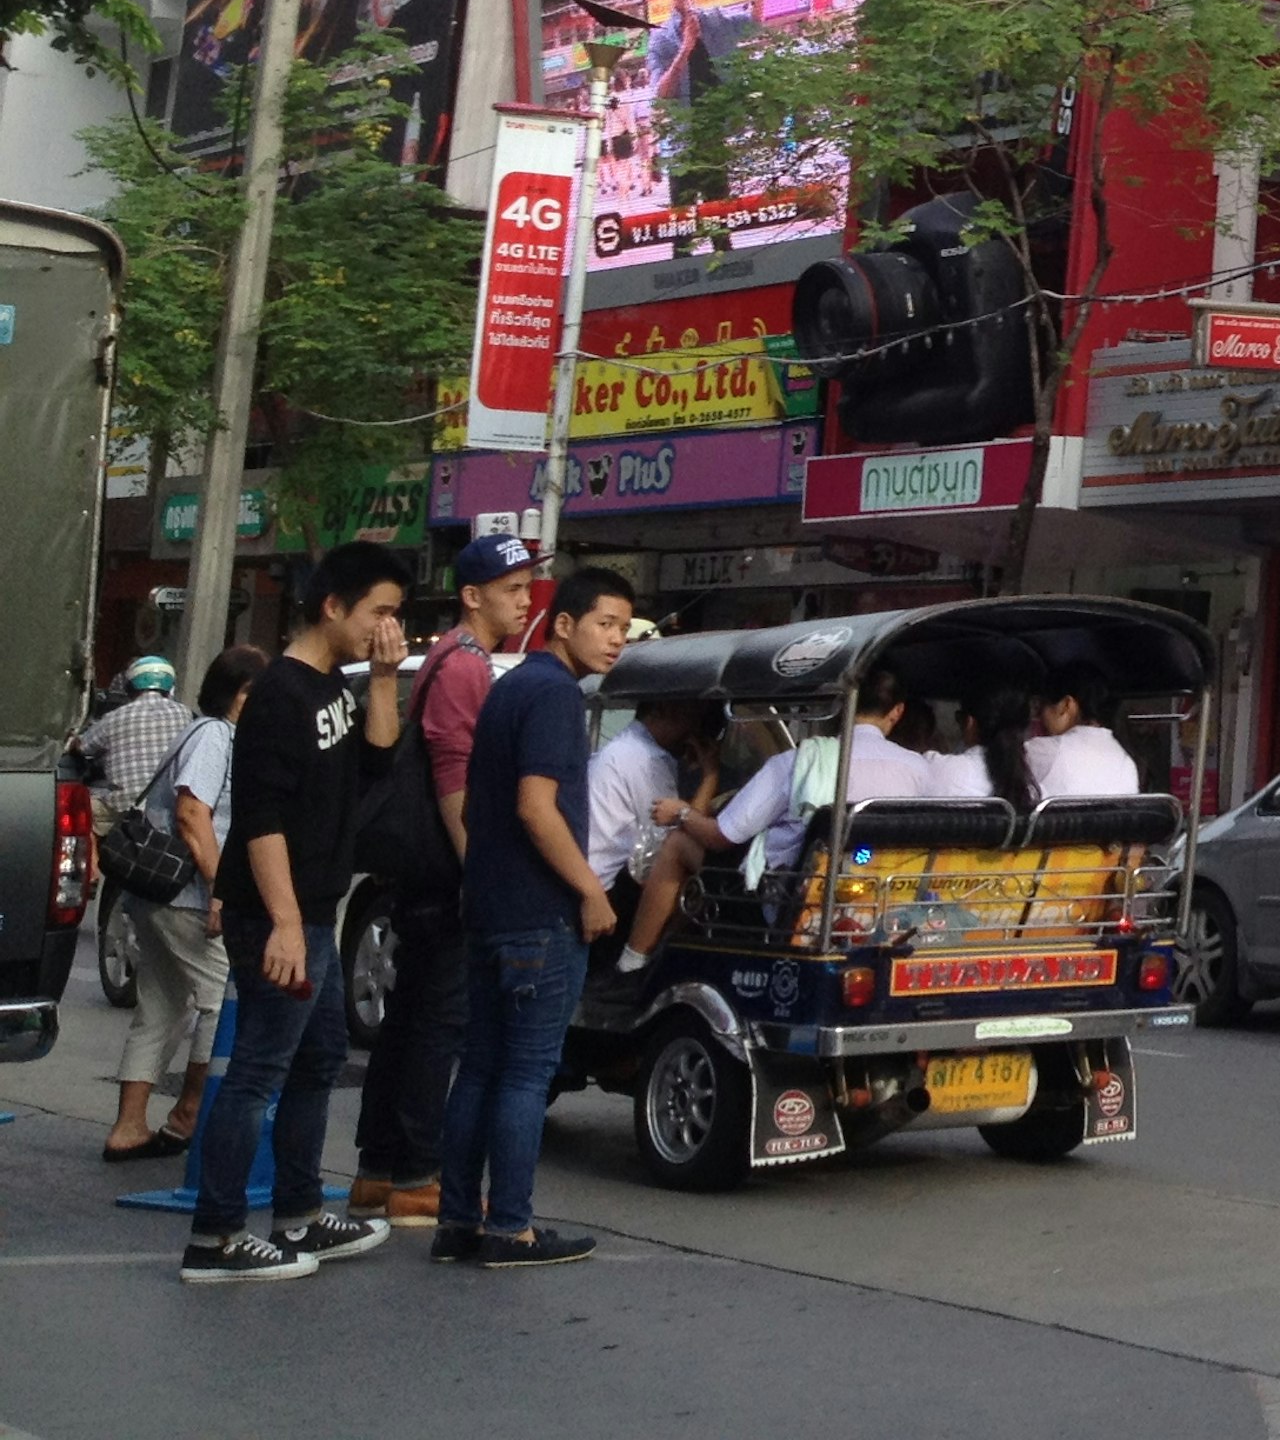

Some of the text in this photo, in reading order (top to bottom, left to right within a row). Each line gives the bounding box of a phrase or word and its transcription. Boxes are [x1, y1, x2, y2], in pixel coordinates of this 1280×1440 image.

[501, 196, 562, 233] 4G
[496, 242, 560, 262] 4G LTE
[1212, 333, 1269, 359] Marco
[694, 354, 757, 402] Ltd.
[864, 455, 979, 498] กานต์ชนก
[905, 955, 1101, 987] THAILAND
